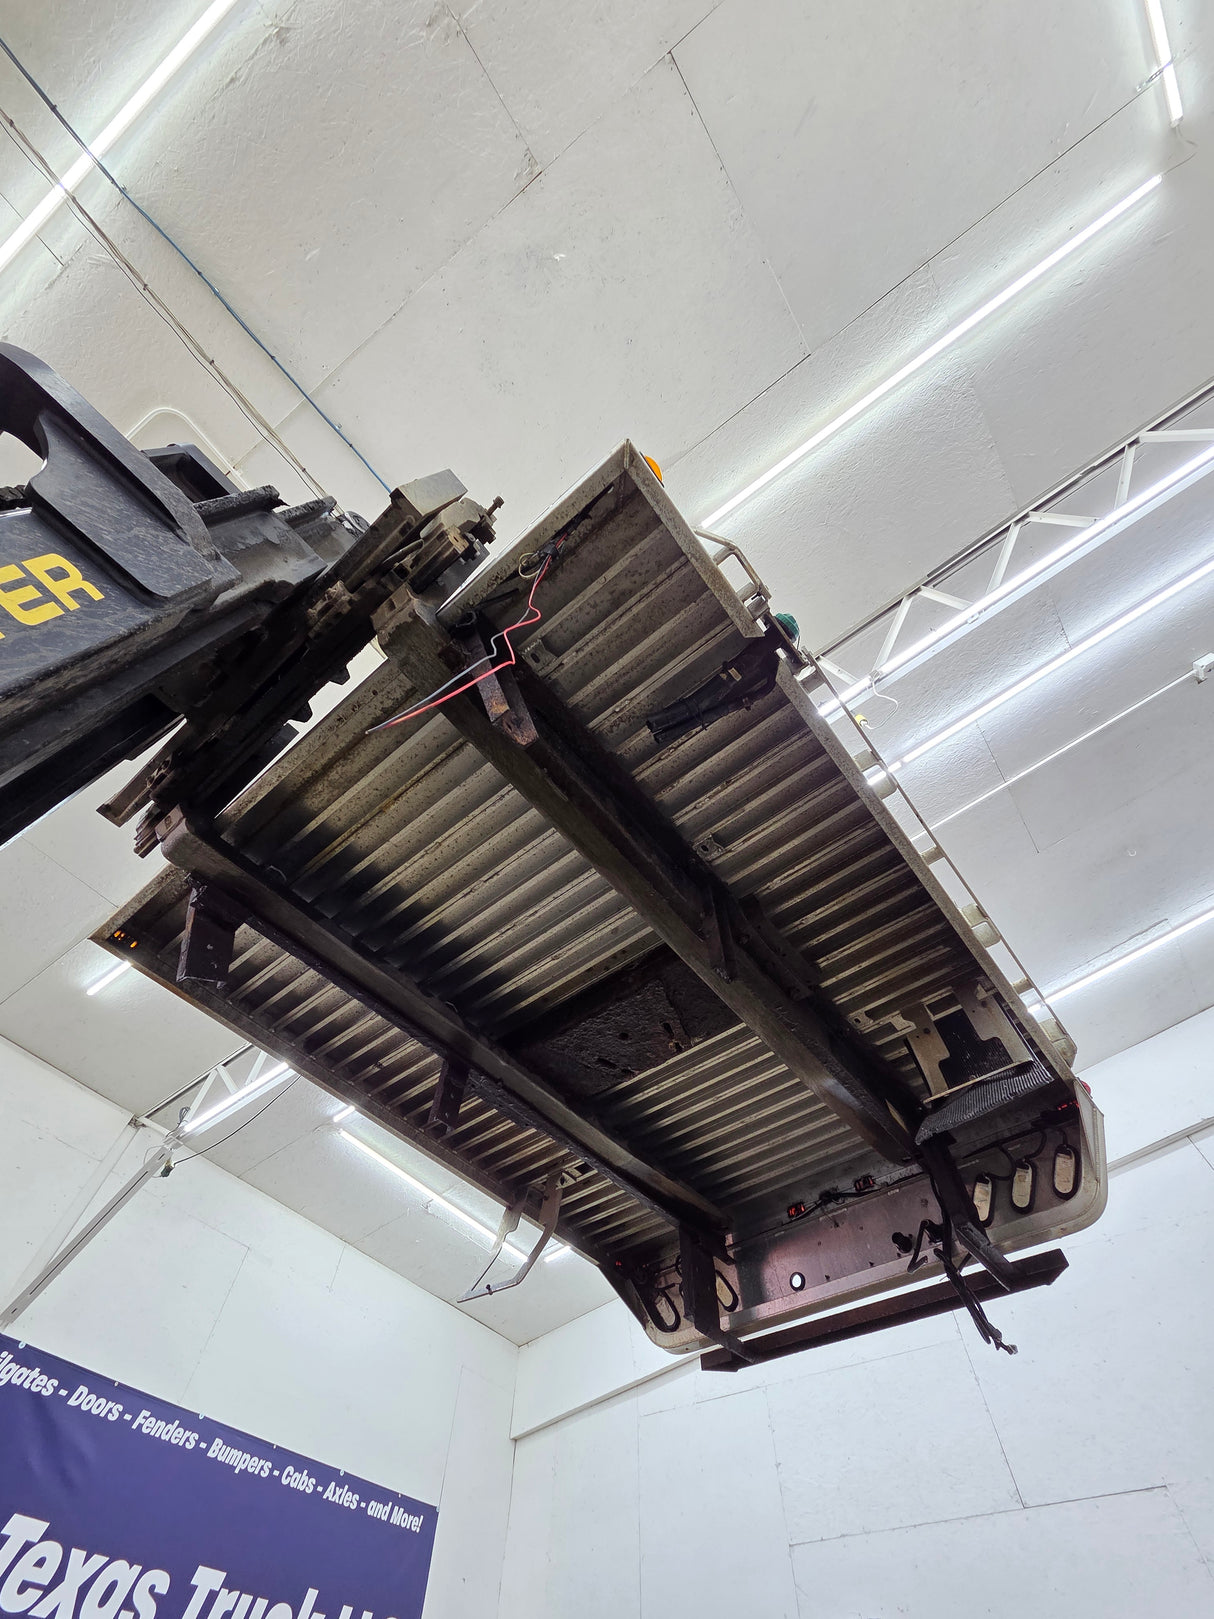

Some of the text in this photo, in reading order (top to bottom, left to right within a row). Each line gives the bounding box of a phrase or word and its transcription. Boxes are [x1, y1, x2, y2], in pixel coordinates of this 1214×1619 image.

[0, 553, 105, 639] ER
[66, 1385, 123, 1421] Doors
[131, 1409, 199, 1450] Fenders
[207, 1438, 272, 1477] Bumpers
[281, 1465, 316, 1493] Cabs
[322, 1481, 360, 1510] Axles
[367, 1500, 392, 1521] and
[389, 1506, 424, 1533] More!
[0, 1513, 171, 1619] Texas
